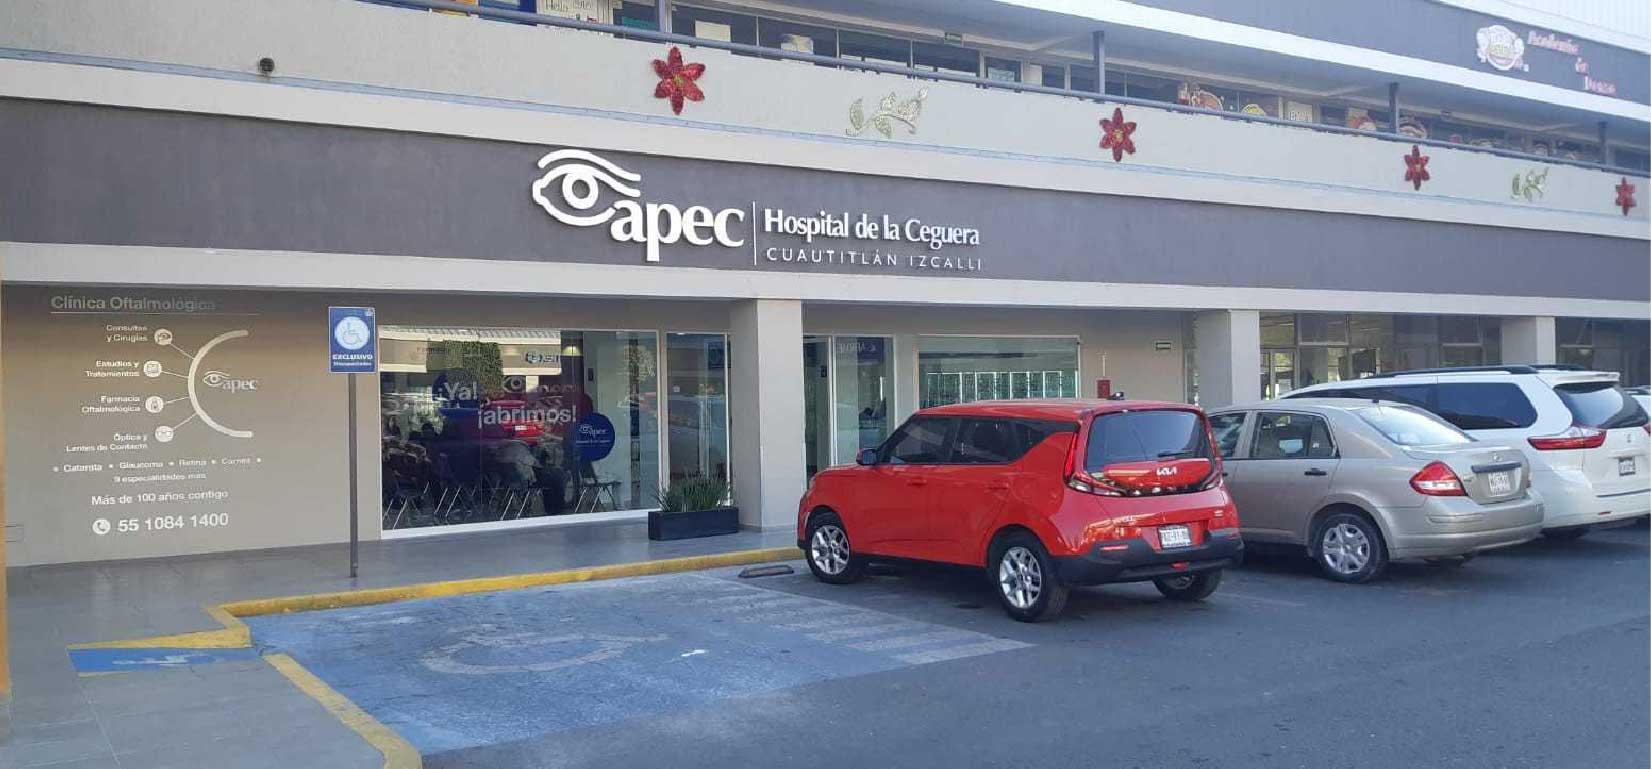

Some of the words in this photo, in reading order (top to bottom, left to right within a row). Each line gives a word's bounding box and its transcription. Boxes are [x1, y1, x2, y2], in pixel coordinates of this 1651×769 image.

[610, 200, 745, 261] apec
[764, 208, 849, 243] Hospital
[855, 213, 879, 240] de
[883, 214, 900, 241] la
[905, 219, 980, 250] Ceguera
[766, 247, 898, 266] CUAUTITLÁN
[910, 255, 983, 270] IZCALLI
[50, 295, 105, 309] Clínica
[223, 379, 257, 394] apec
[118, 494, 133, 504] de
[137, 492, 156, 503] 100
[158, 491, 185, 501] años
[188, 490, 229, 500] contigo
[117, 519, 140, 532] 55
[144, 515, 185, 531] 1084
[189, 512, 230, 527] 1400
